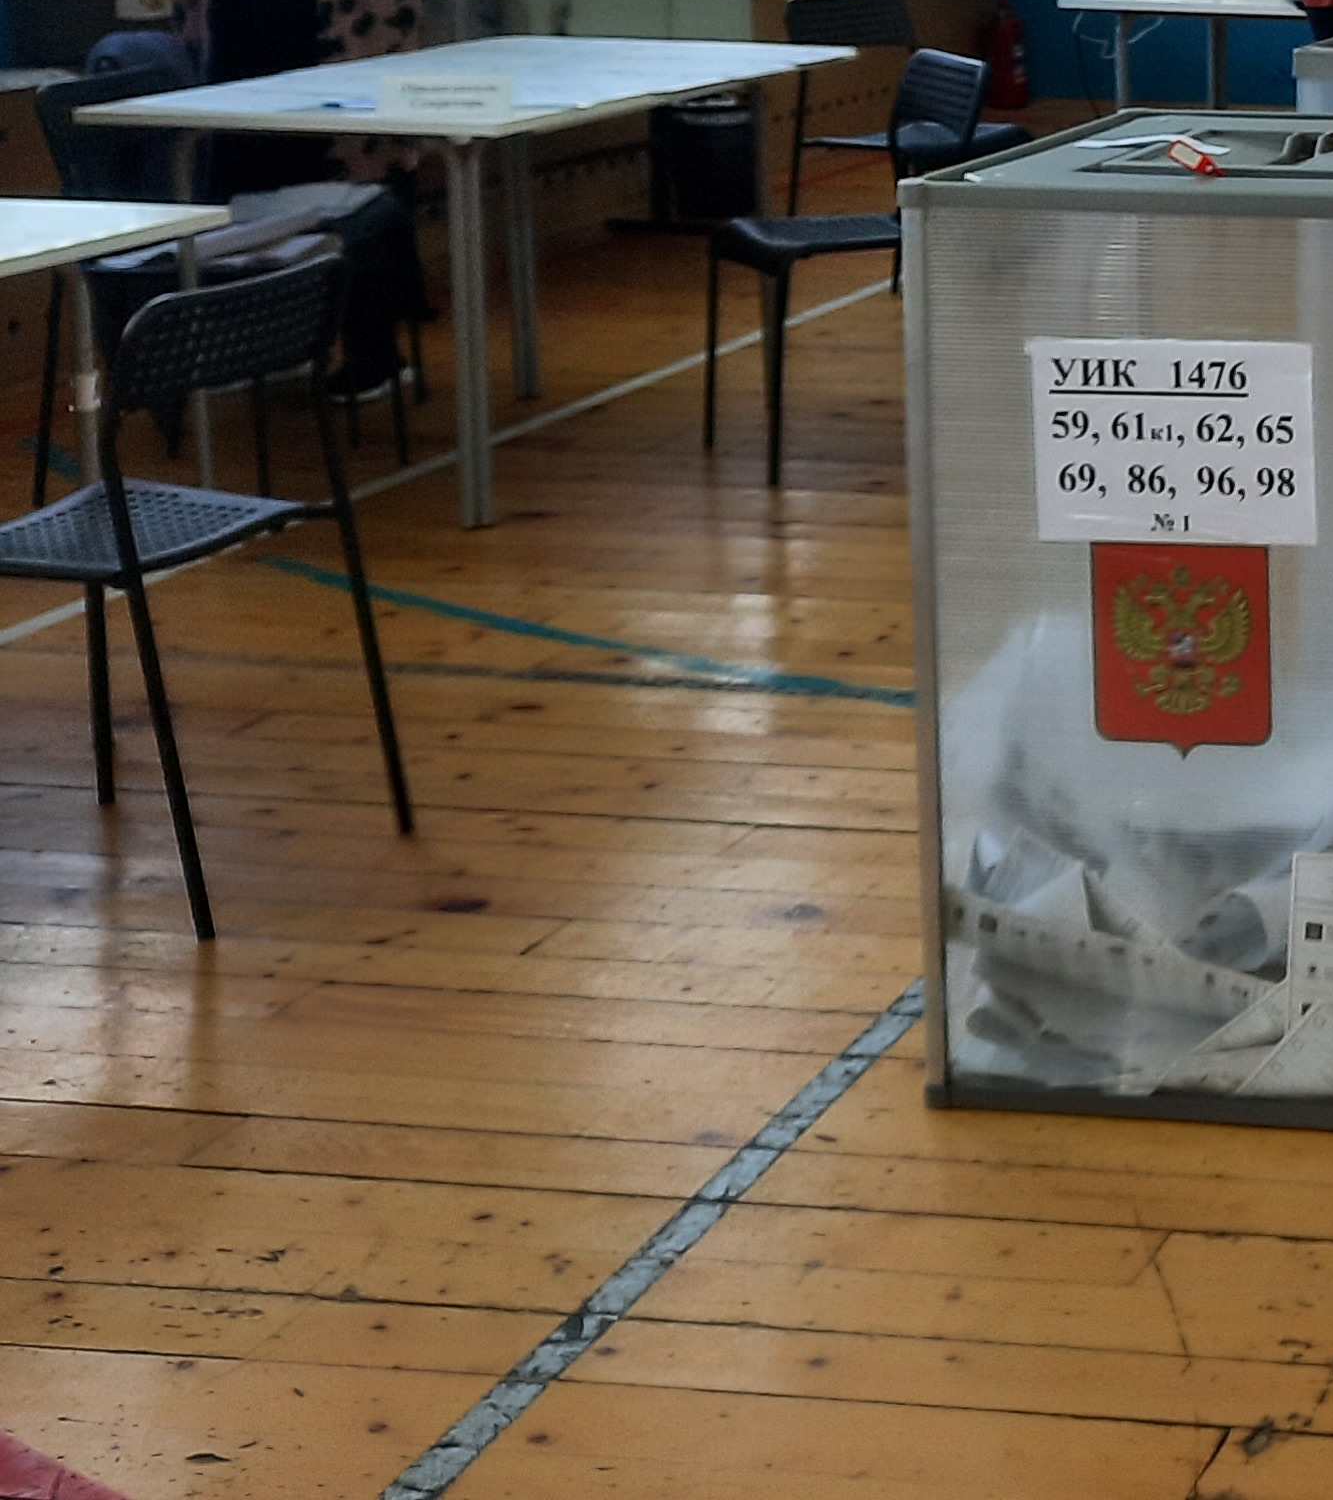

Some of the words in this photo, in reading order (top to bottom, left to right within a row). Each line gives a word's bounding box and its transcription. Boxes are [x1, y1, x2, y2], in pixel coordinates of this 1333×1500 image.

[1051, 358, 1138, 388] УИК
[1171, 360, 1248, 391] 1476
[1051, 410, 1101, 445] 59,
[1196, 413, 1245, 449] 62,
[1256, 415, 1295, 444] 65
[1058, 463, 1107, 499] 69,
[1127, 464, 1177, 499] 86,
[1197, 466, 1246, 502] 96,
[1256, 468, 1296, 497] 98
[1151, 513, 1175, 533] №
[1183, 515, 1191, 533] 1
